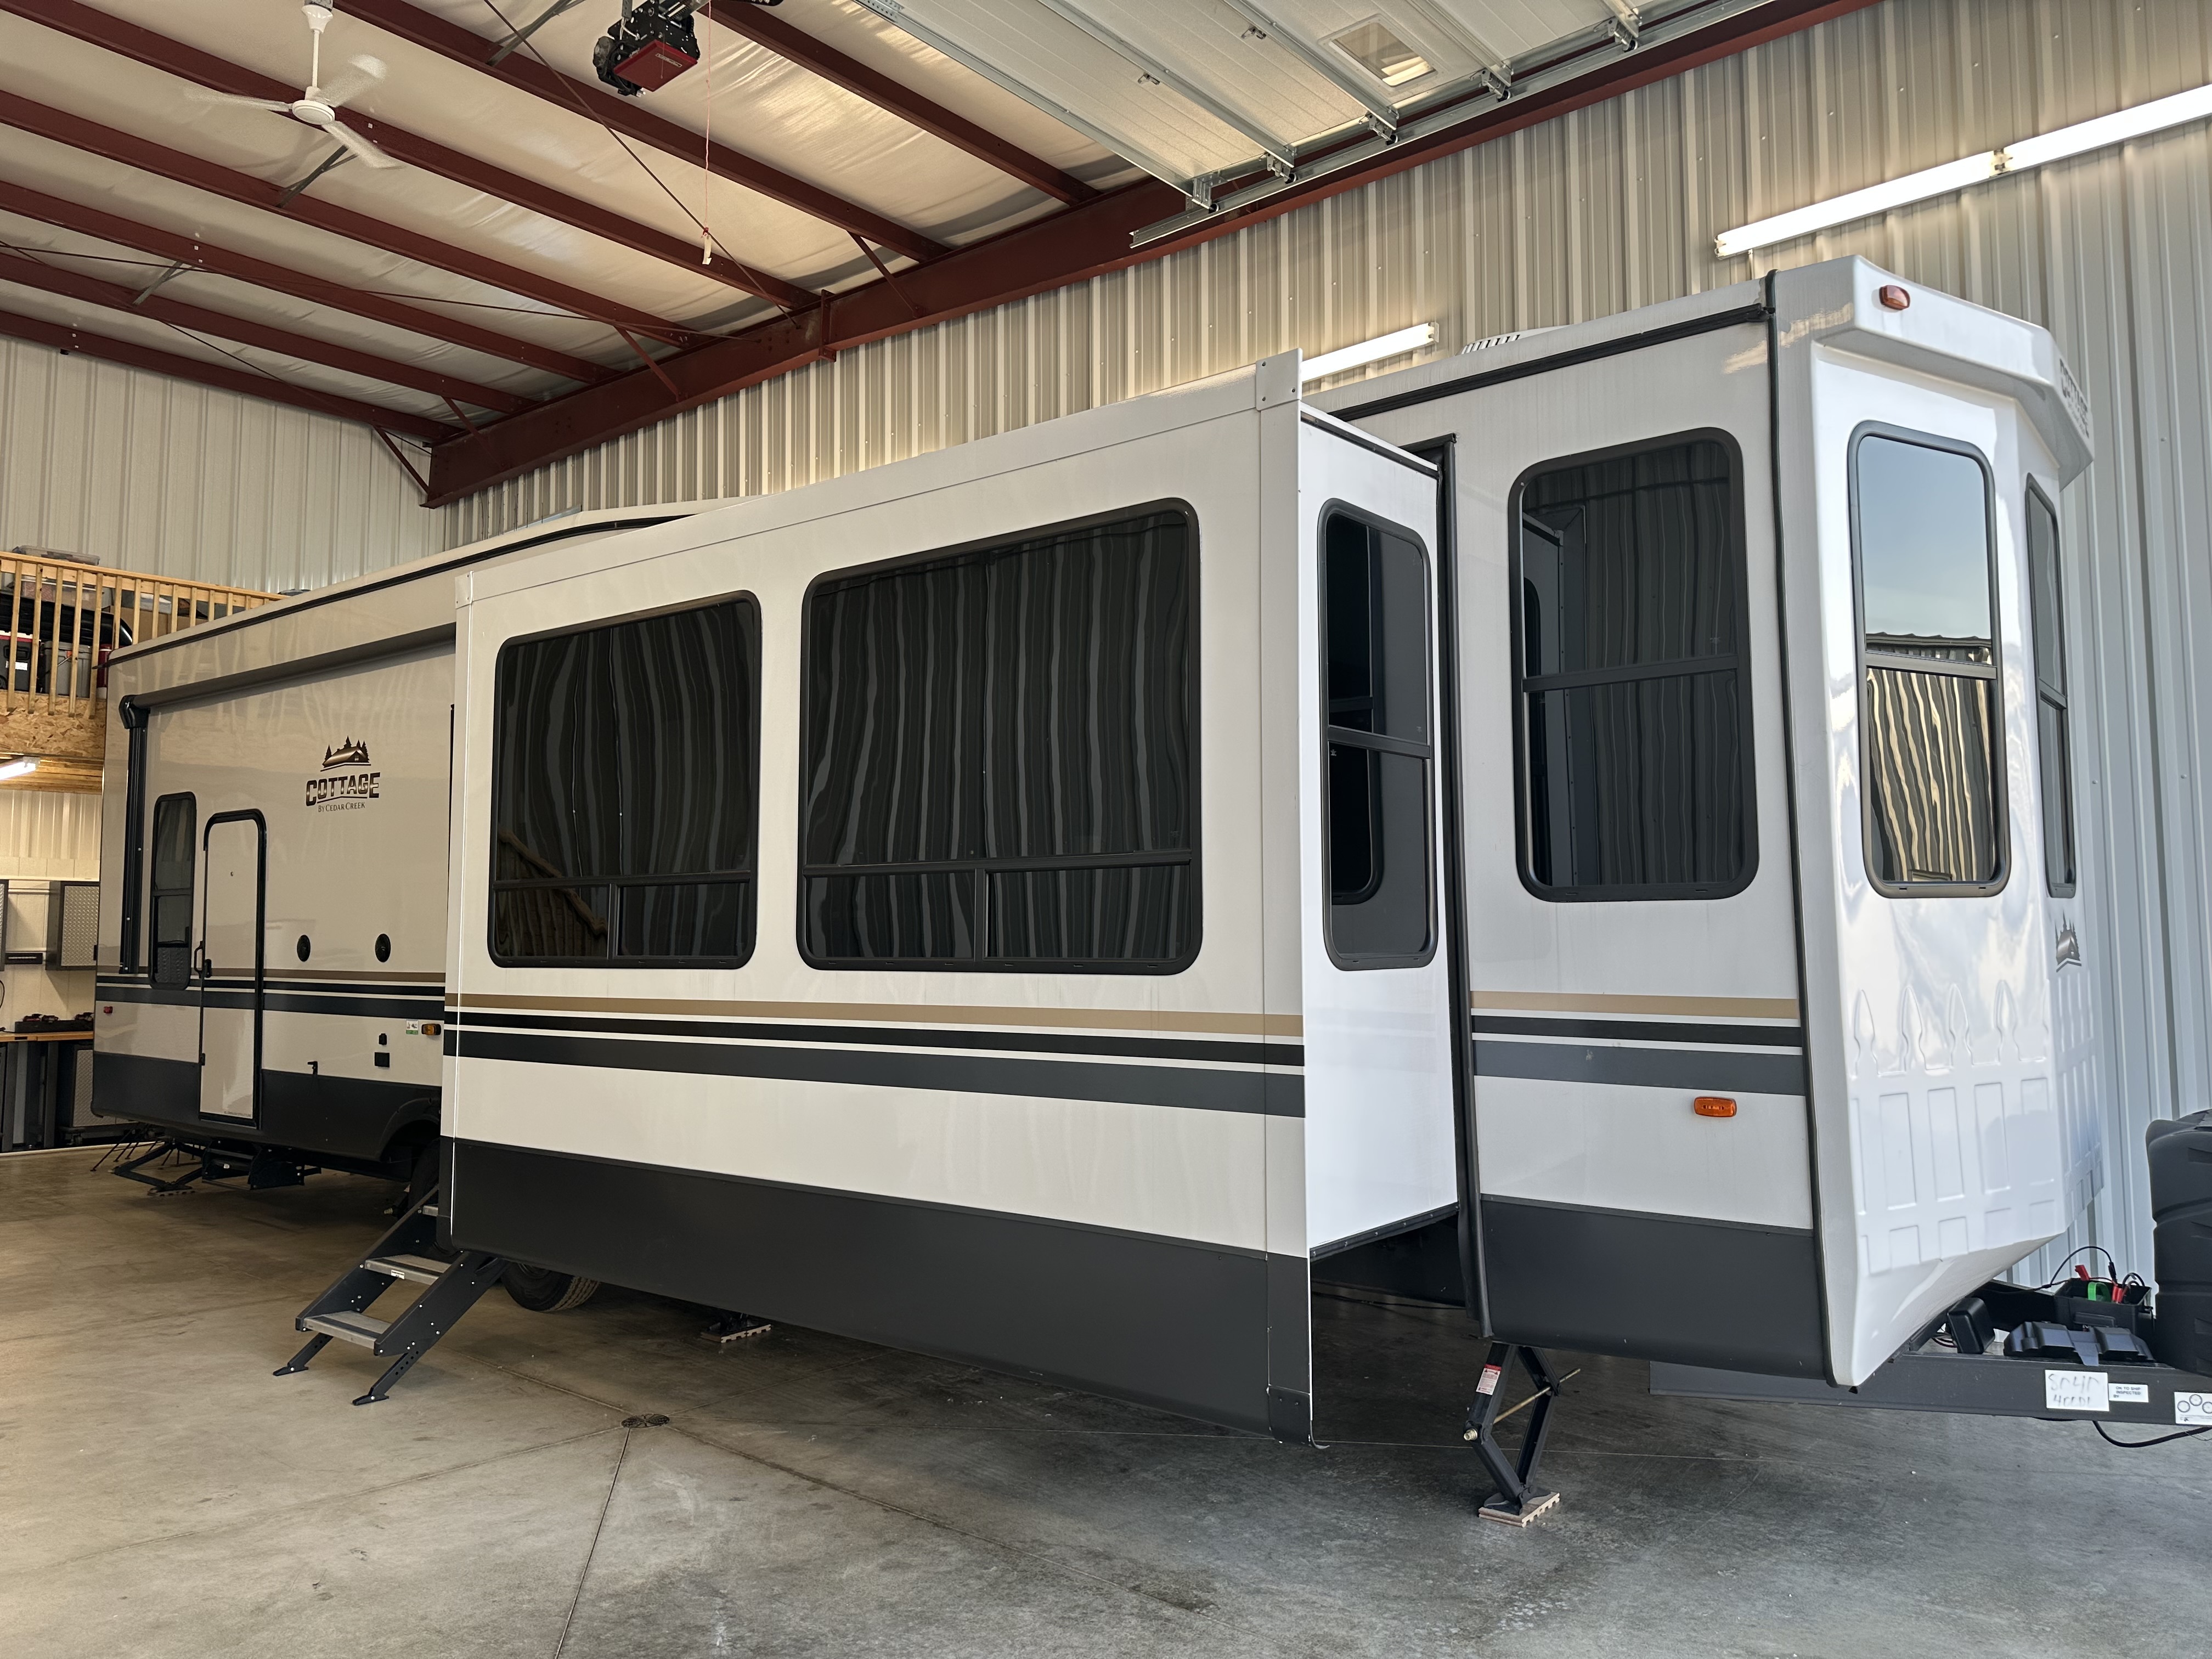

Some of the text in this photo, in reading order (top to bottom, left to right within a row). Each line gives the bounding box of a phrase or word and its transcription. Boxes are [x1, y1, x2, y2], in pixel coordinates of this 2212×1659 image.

[306, 772, 380, 806] COTTAGE
[325, 804, 345, 812] CEDAR
[345, 802, 365, 810] CREEK
